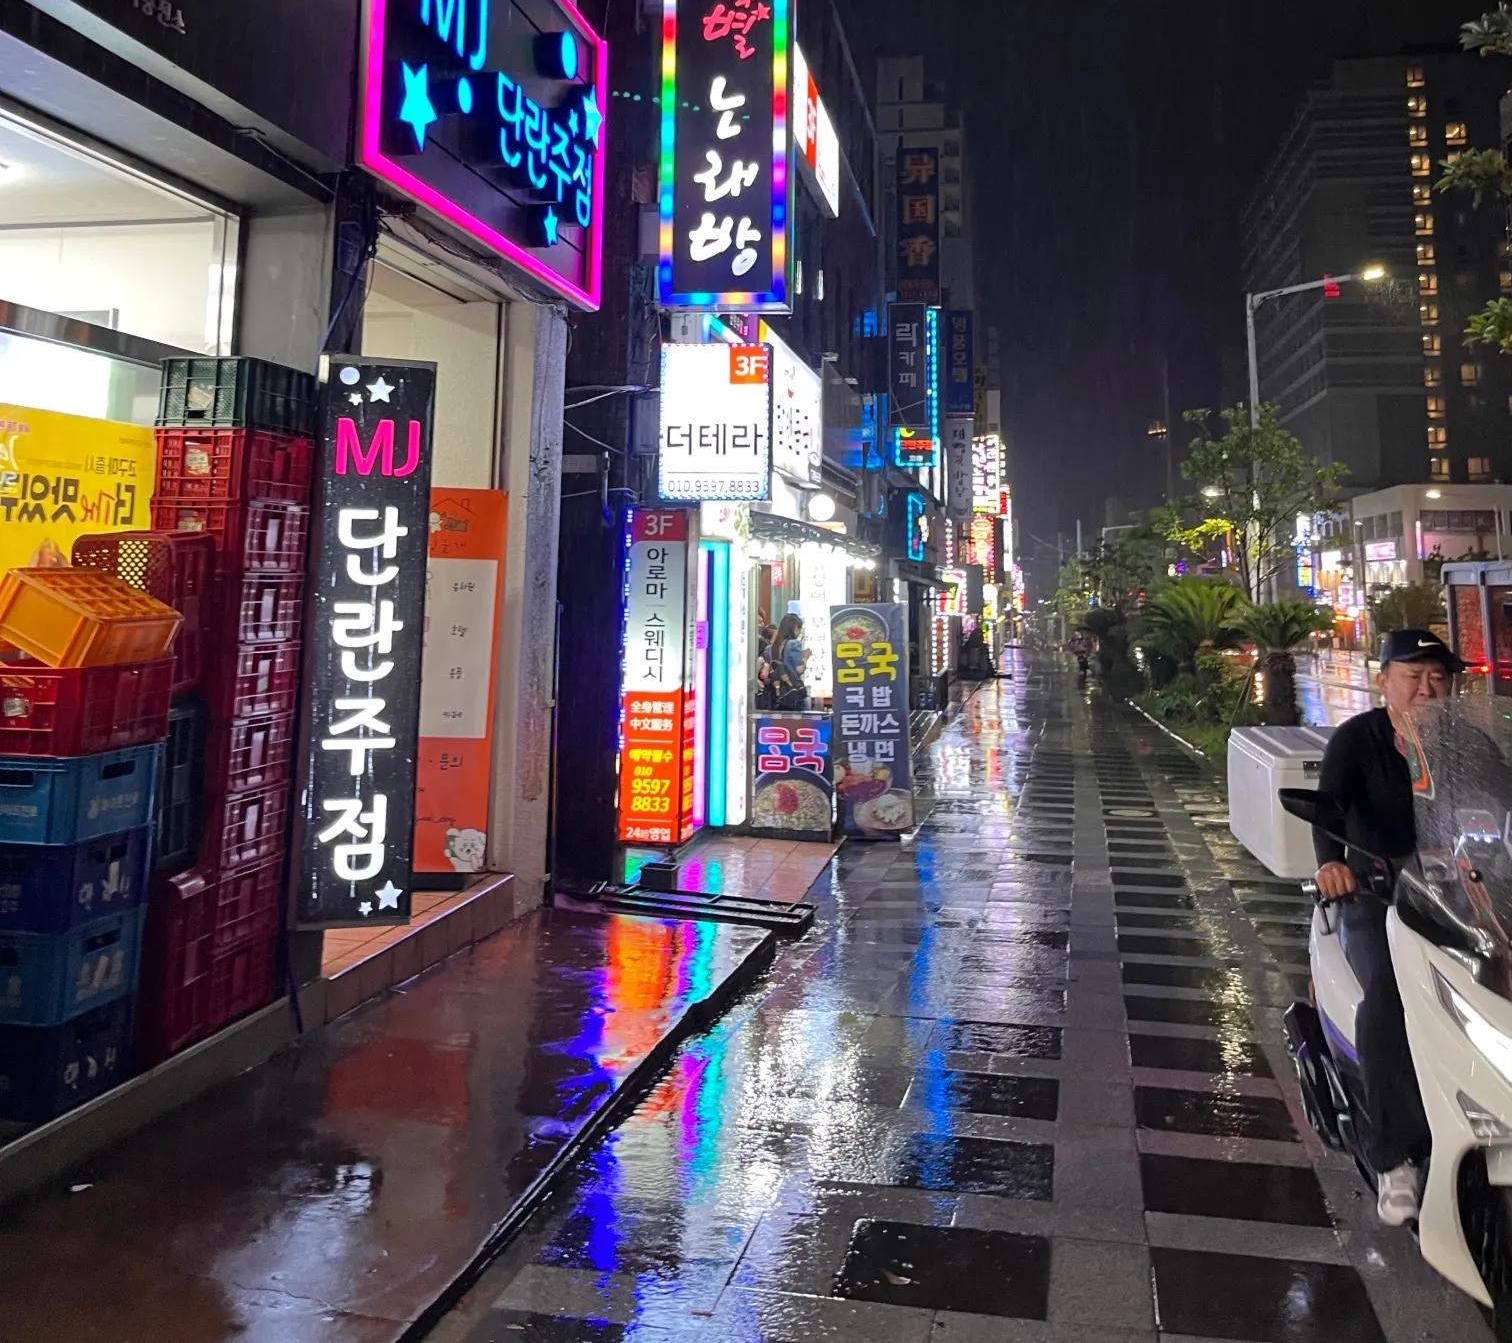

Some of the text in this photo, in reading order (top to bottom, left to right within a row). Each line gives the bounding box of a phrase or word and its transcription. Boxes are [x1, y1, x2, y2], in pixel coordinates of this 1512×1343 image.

[498, 71, 593, 228] 단란주점
[689, 77, 762, 276] 노래방
[735, 355, 767, 376] 3F
[334, 416, 421, 477] MJ
[667, 423, 763, 456] 더테라
[644, 515, 674, 536] 3F
[646, 546, 669, 600] 아로마
[643, 613, 665, 683] 스웨디시
[318, 505, 409, 883] 단란주점
[841, 713, 900, 735] 돈까스
[631, 778, 671, 796] 9597
[634, 765, 653, 777] 010
[631, 795, 670, 813] 8833
